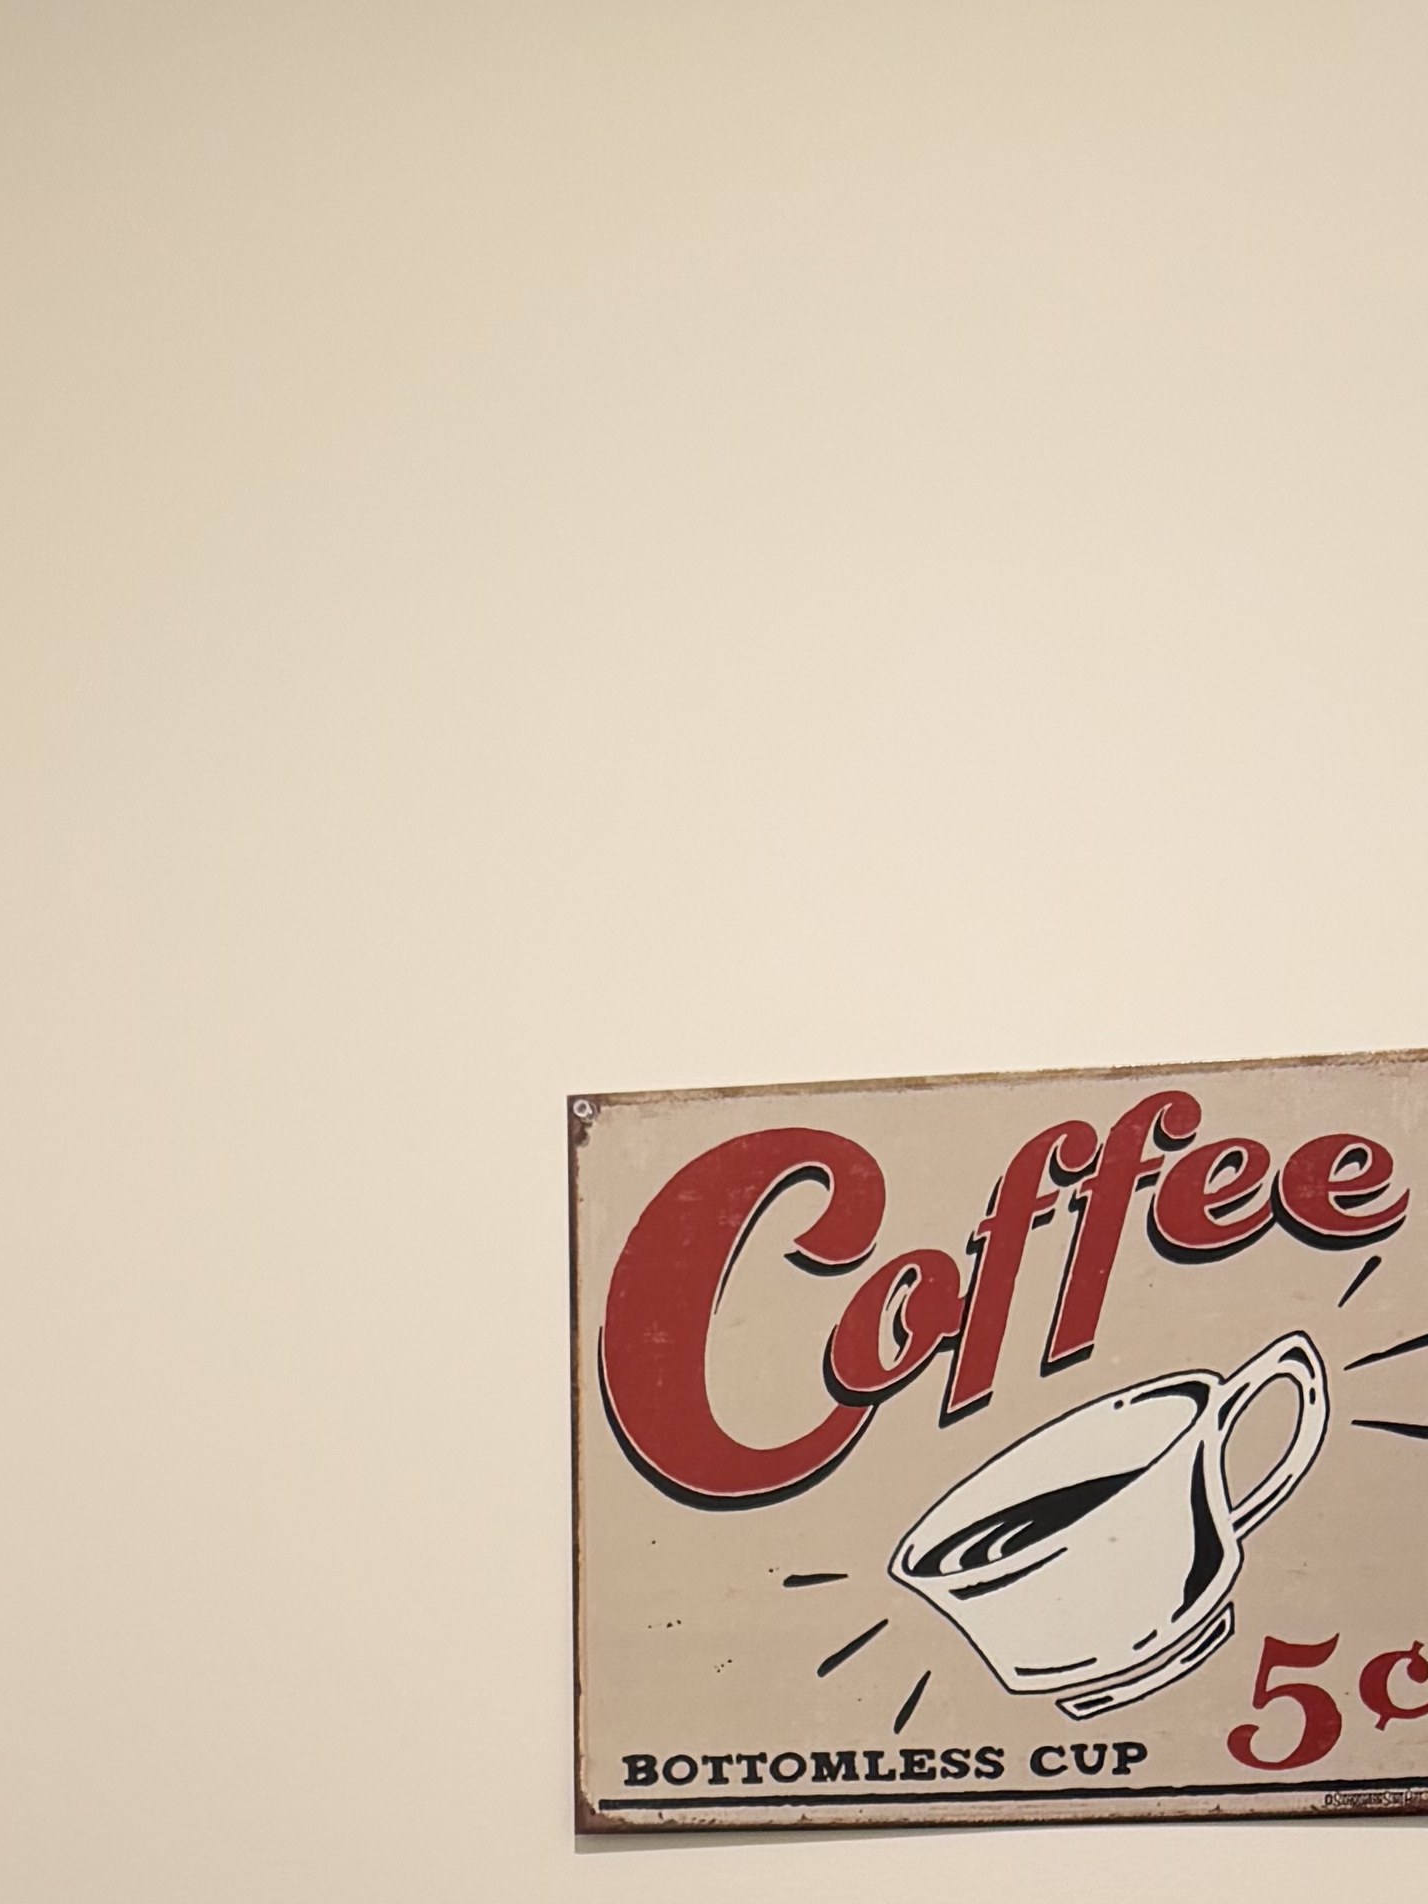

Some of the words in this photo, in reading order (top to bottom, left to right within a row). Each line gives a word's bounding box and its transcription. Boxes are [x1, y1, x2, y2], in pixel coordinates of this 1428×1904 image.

[598, 1090, 1410, 1510] Coffee
[624, 1746, 1006, 1788] BOTTOMLESS
[1029, 1742, 1150, 1779] CUP
